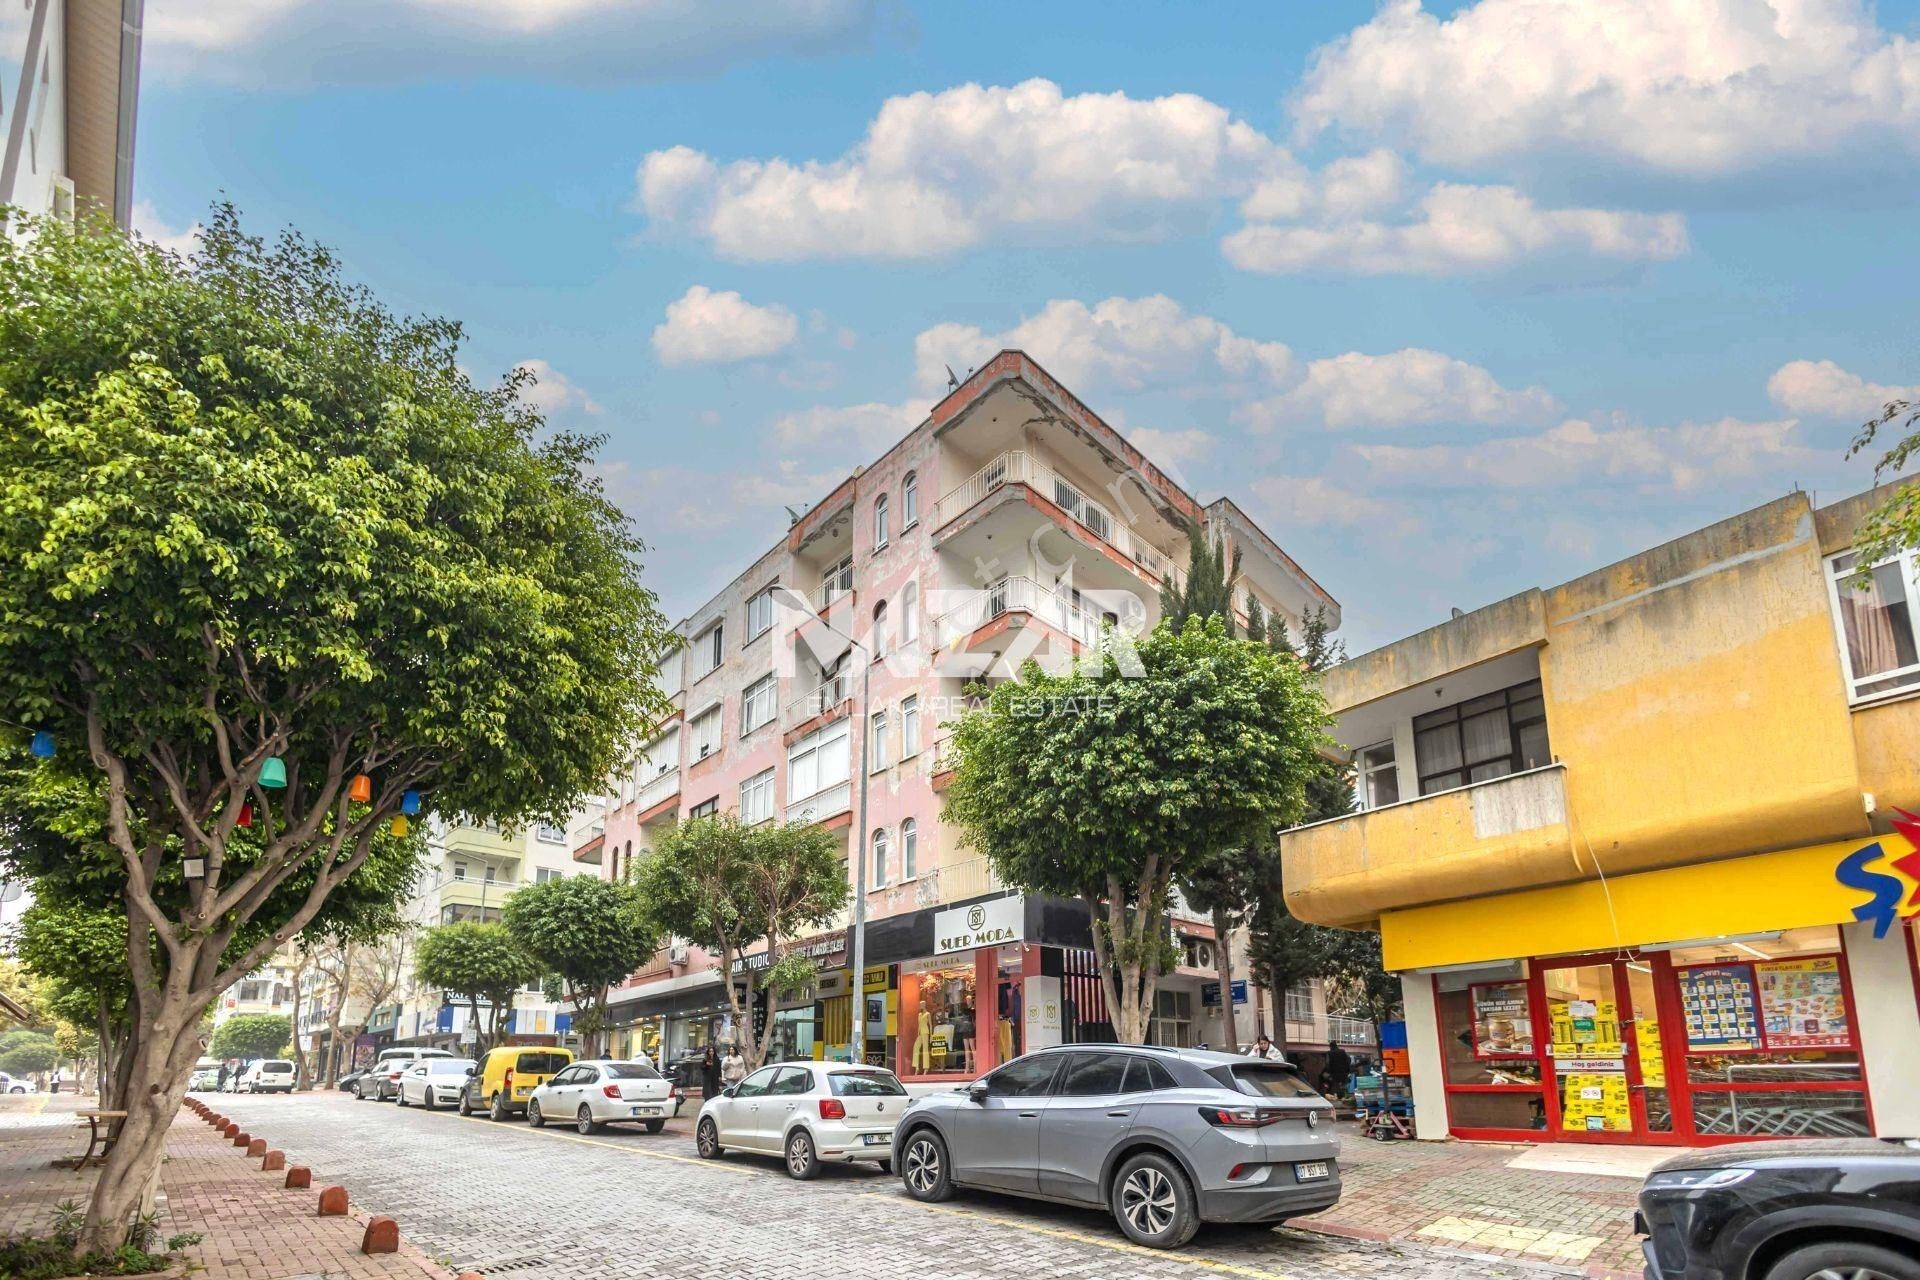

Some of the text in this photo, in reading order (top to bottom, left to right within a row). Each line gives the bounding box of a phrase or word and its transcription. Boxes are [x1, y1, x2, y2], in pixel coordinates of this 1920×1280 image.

[941, 926, 1015, 951] SUER MODA
[731, 959, 743, 973] AIR
